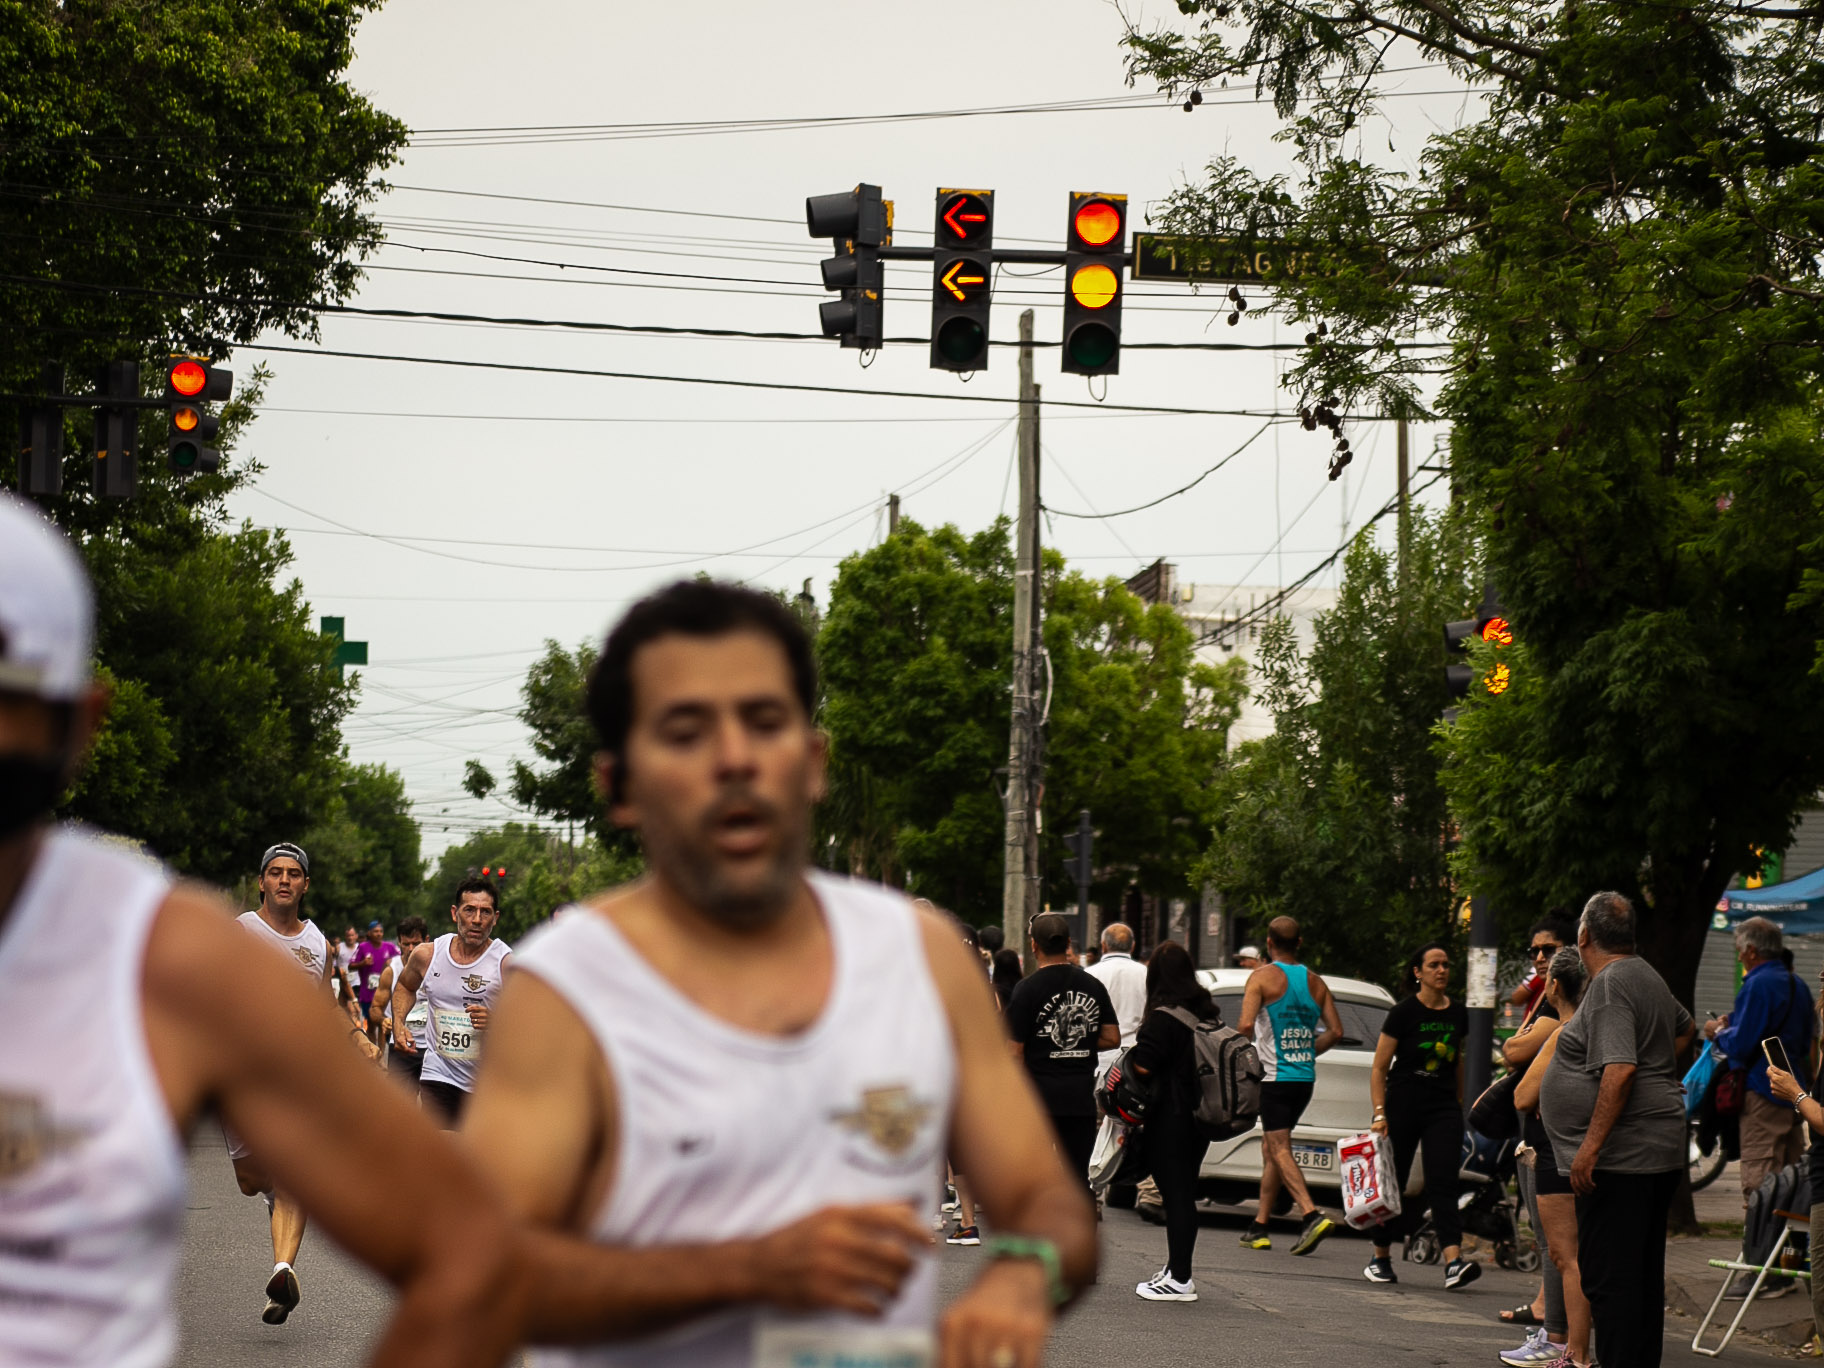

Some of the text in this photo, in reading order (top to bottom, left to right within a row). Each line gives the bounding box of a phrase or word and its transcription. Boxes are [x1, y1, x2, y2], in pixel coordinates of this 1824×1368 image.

[1280, 1026, 1312, 1039] JESÚS
[441, 1031, 470, 1049] 550
[1280, 1040, 1312, 1049] SALVA
[1294, 1152, 1328, 1167] 58 RB
